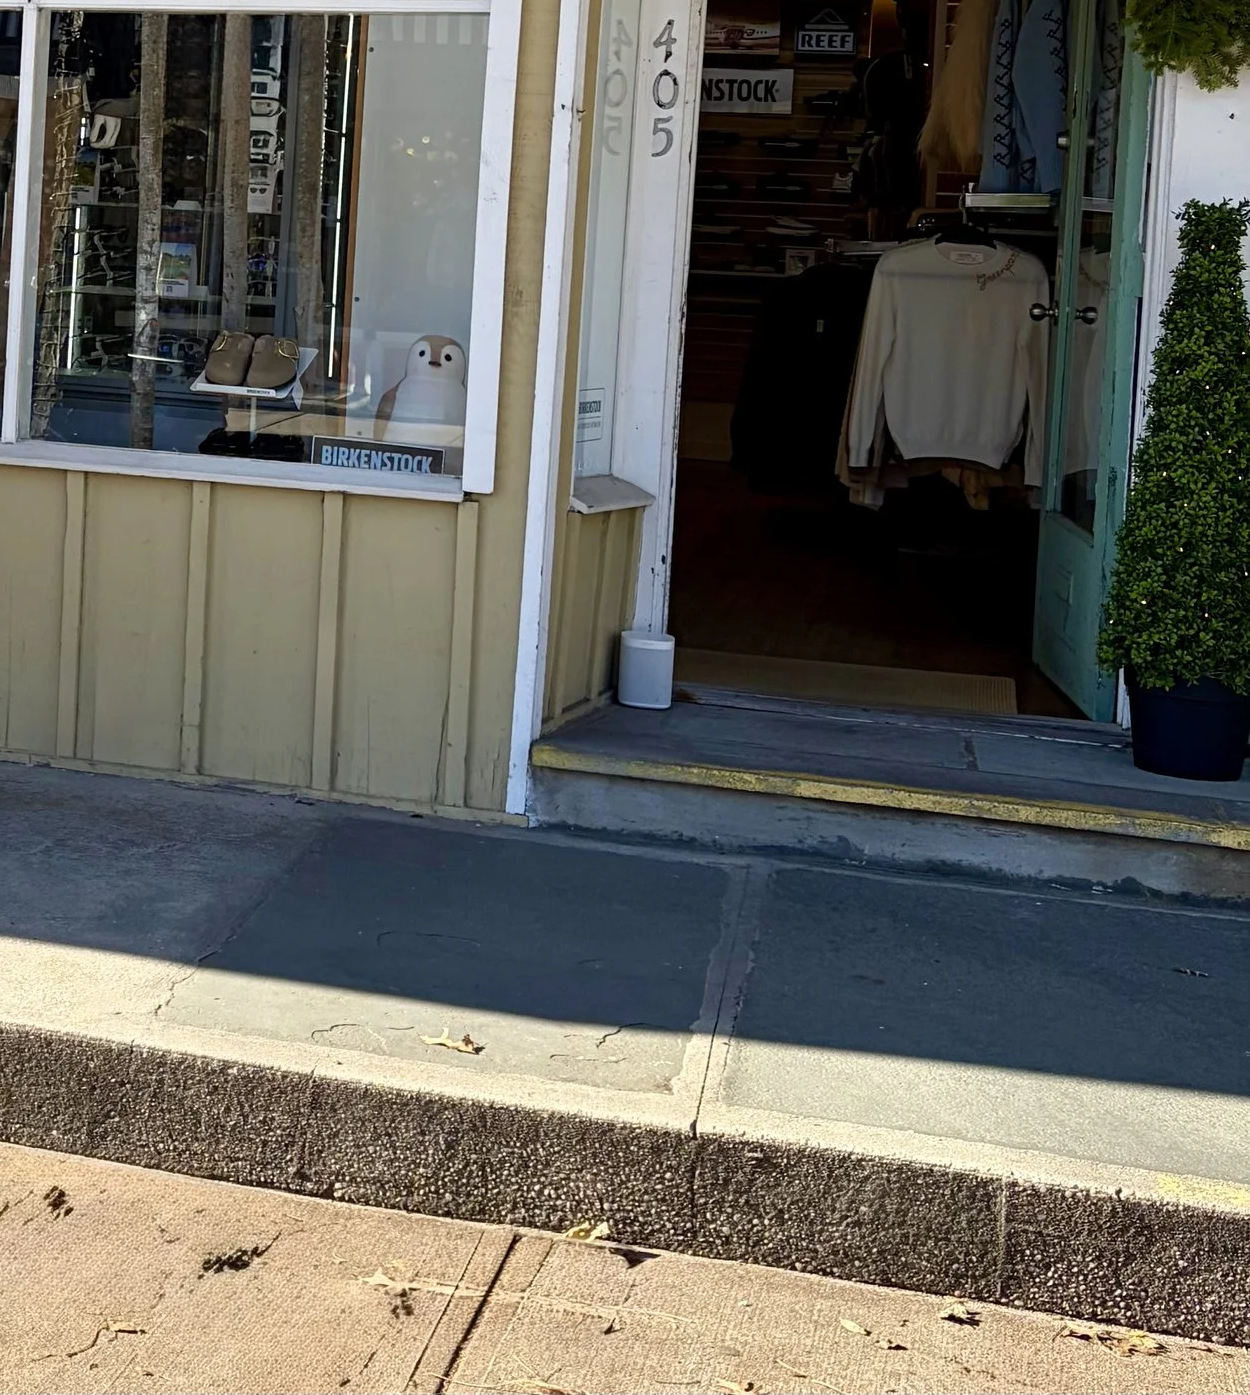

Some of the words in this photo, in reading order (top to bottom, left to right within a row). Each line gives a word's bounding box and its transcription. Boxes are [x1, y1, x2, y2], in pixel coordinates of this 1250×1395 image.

[801, 34, 851, 48] REEF
[651, 19, 679, 157] 405
[321, 445, 434, 474] BIRKENSTOCK
